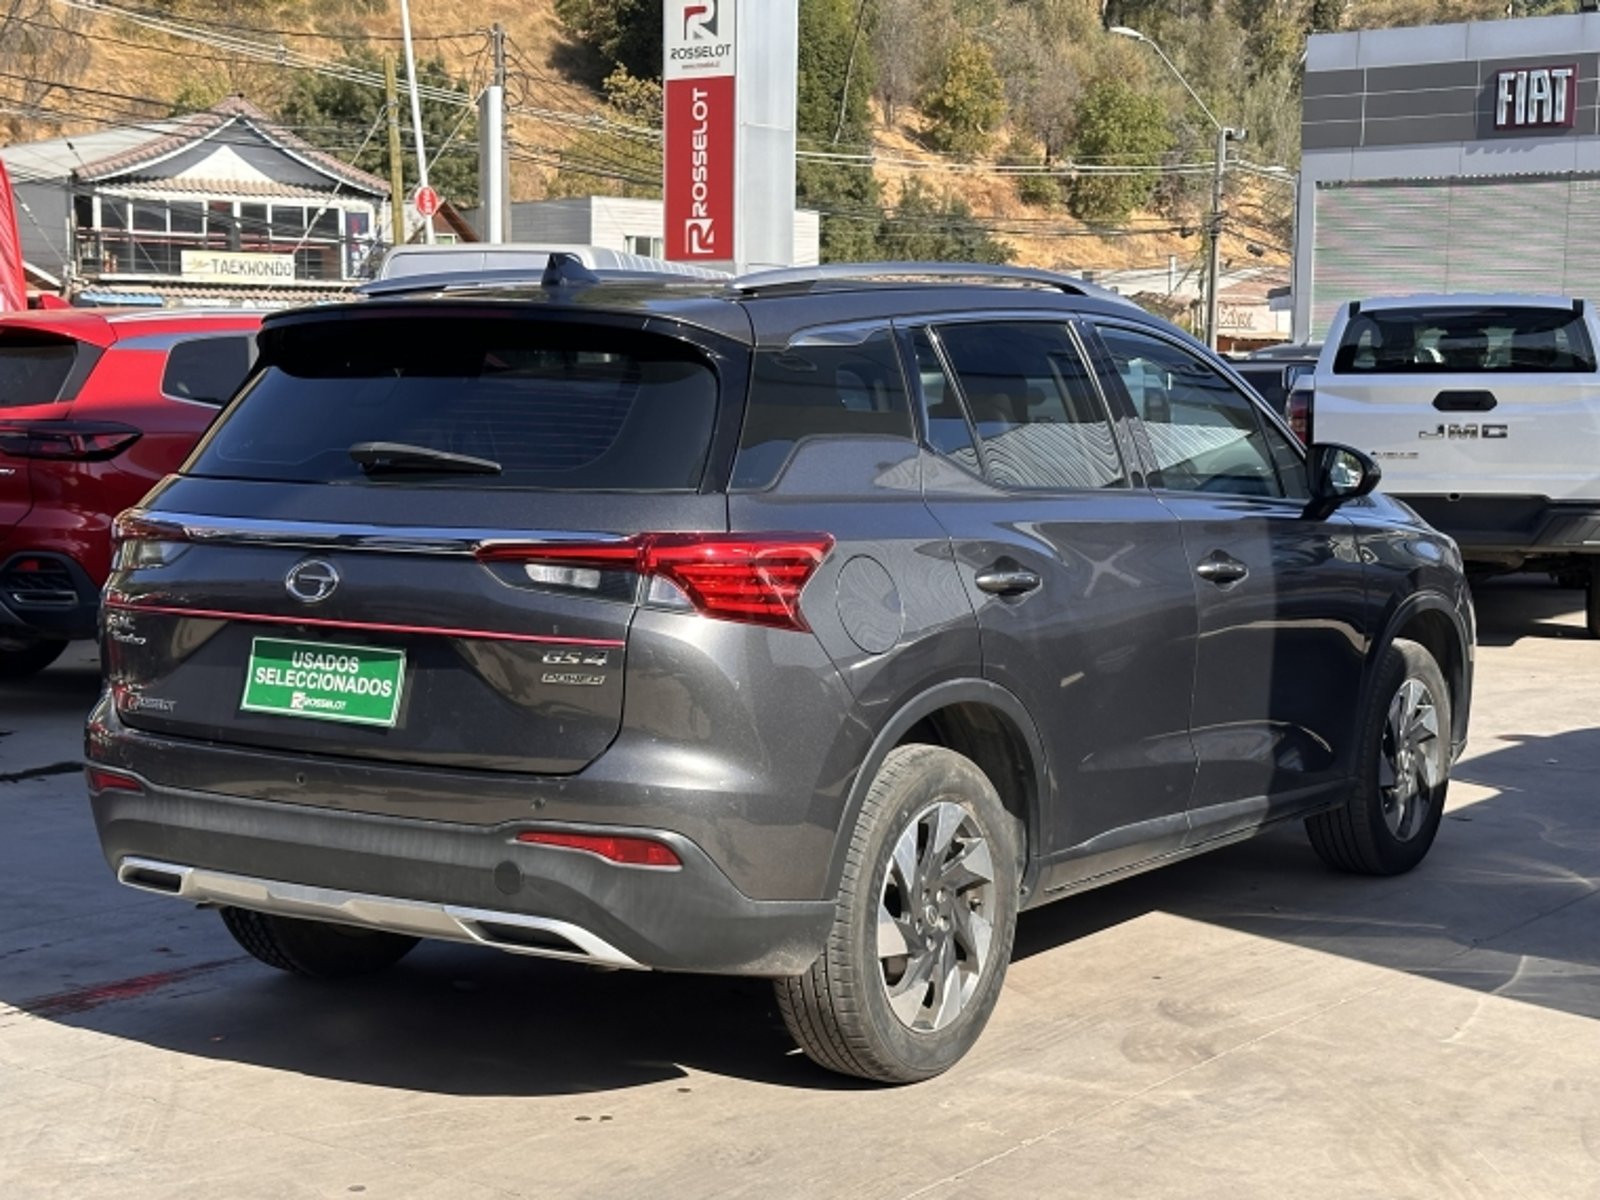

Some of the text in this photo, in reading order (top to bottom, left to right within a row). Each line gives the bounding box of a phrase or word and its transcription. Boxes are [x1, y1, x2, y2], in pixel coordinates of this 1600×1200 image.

[670, 43, 731, 59] ROSSELOT
[1496, 69, 1573, 125] FIAT
[692, 88, 708, 218] ROSSELOT
[211, 259, 292, 276] TAEKWONDO
[1418, 424, 1508, 439] JMC
[292, 651, 359, 673] USADOS
[255, 667, 392, 697] SELECCIONADOS
